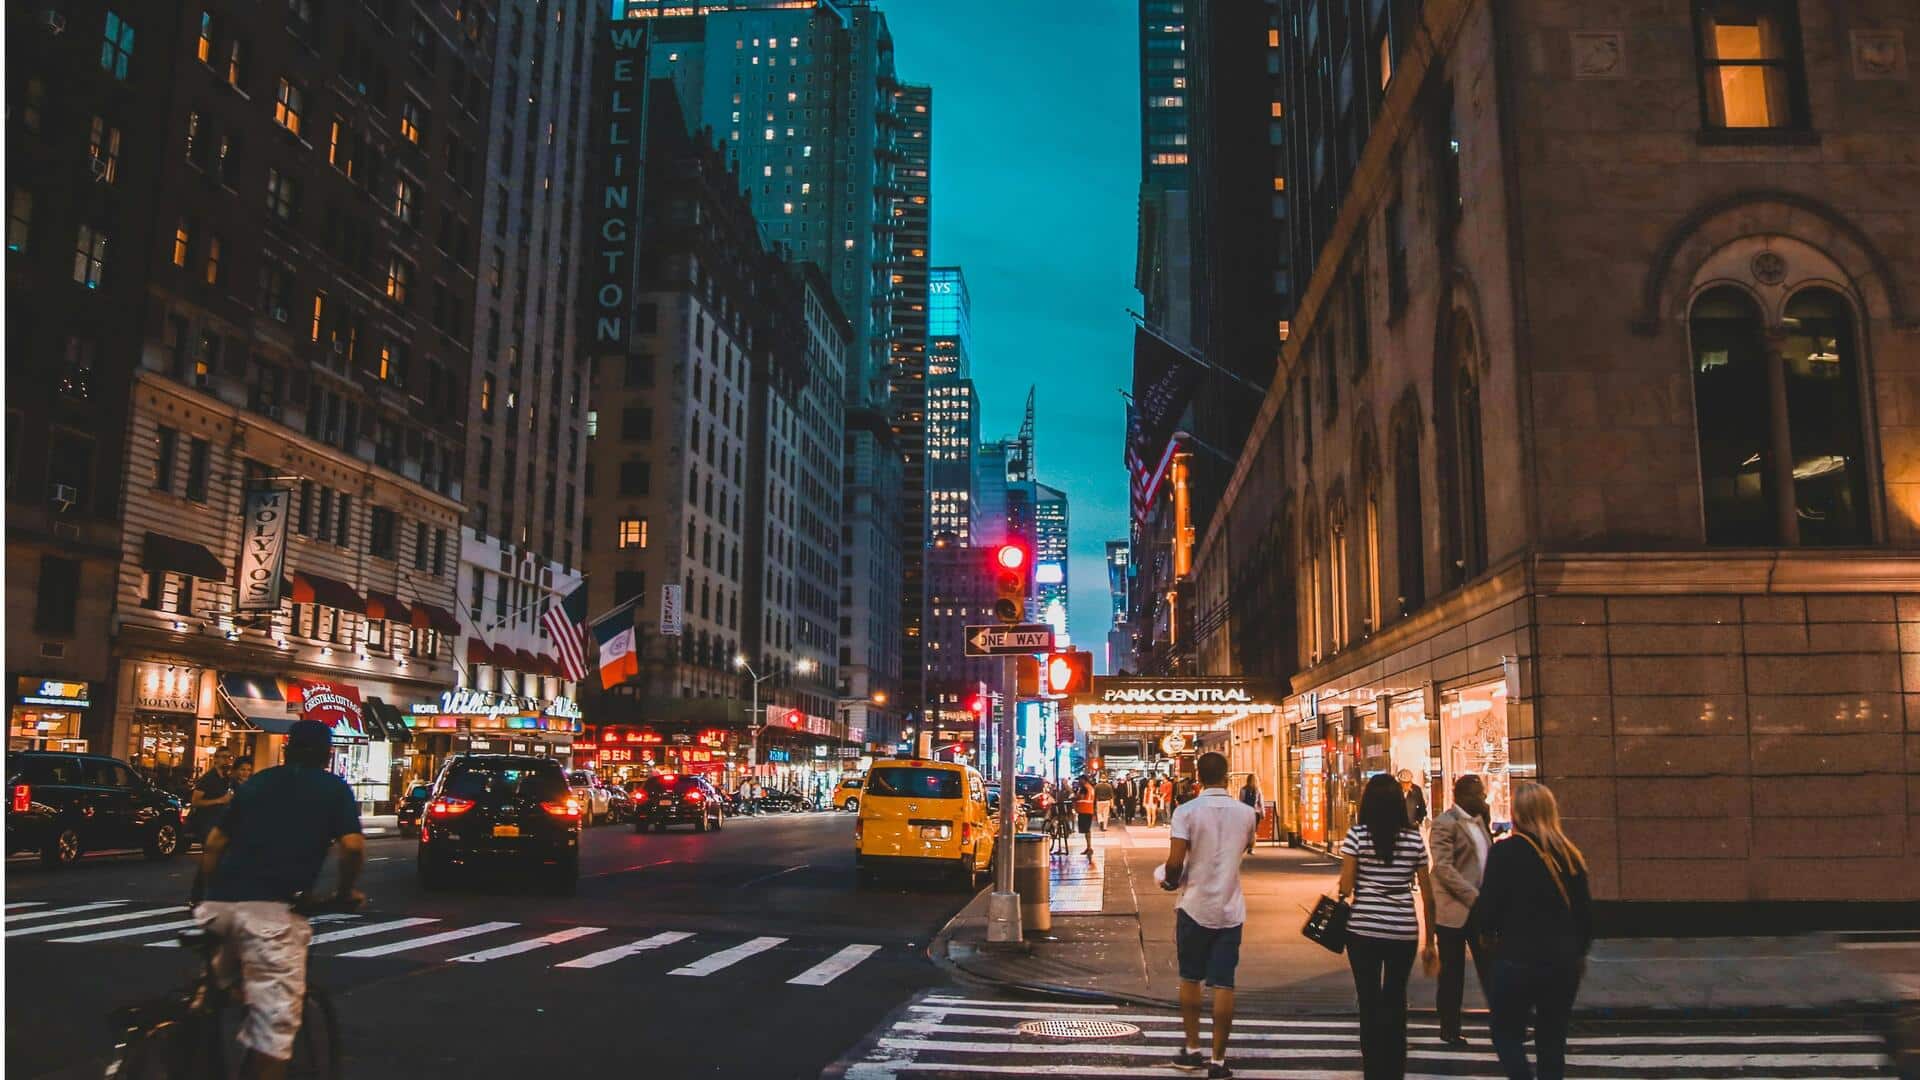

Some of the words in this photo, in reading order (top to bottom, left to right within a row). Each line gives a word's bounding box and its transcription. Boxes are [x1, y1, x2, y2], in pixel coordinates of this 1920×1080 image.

[596, 28, 643, 343] WELLINGTON
[249, 494, 281, 598] MOLYVOS
[980, 634, 1004, 646] ONE
[1016, 633, 1044, 646] WAY
[137, 696, 198, 711] MOLYVOS
[304, 693, 336, 713] CHRISTMAS
[1104, 687, 1154, 703] PARK
[1155, 687, 1252, 703] CENTRAL
[412, 704, 440, 715] HOTEL
[442, 689, 520, 720] Wellington
[600, 749, 632, 761] BEN
